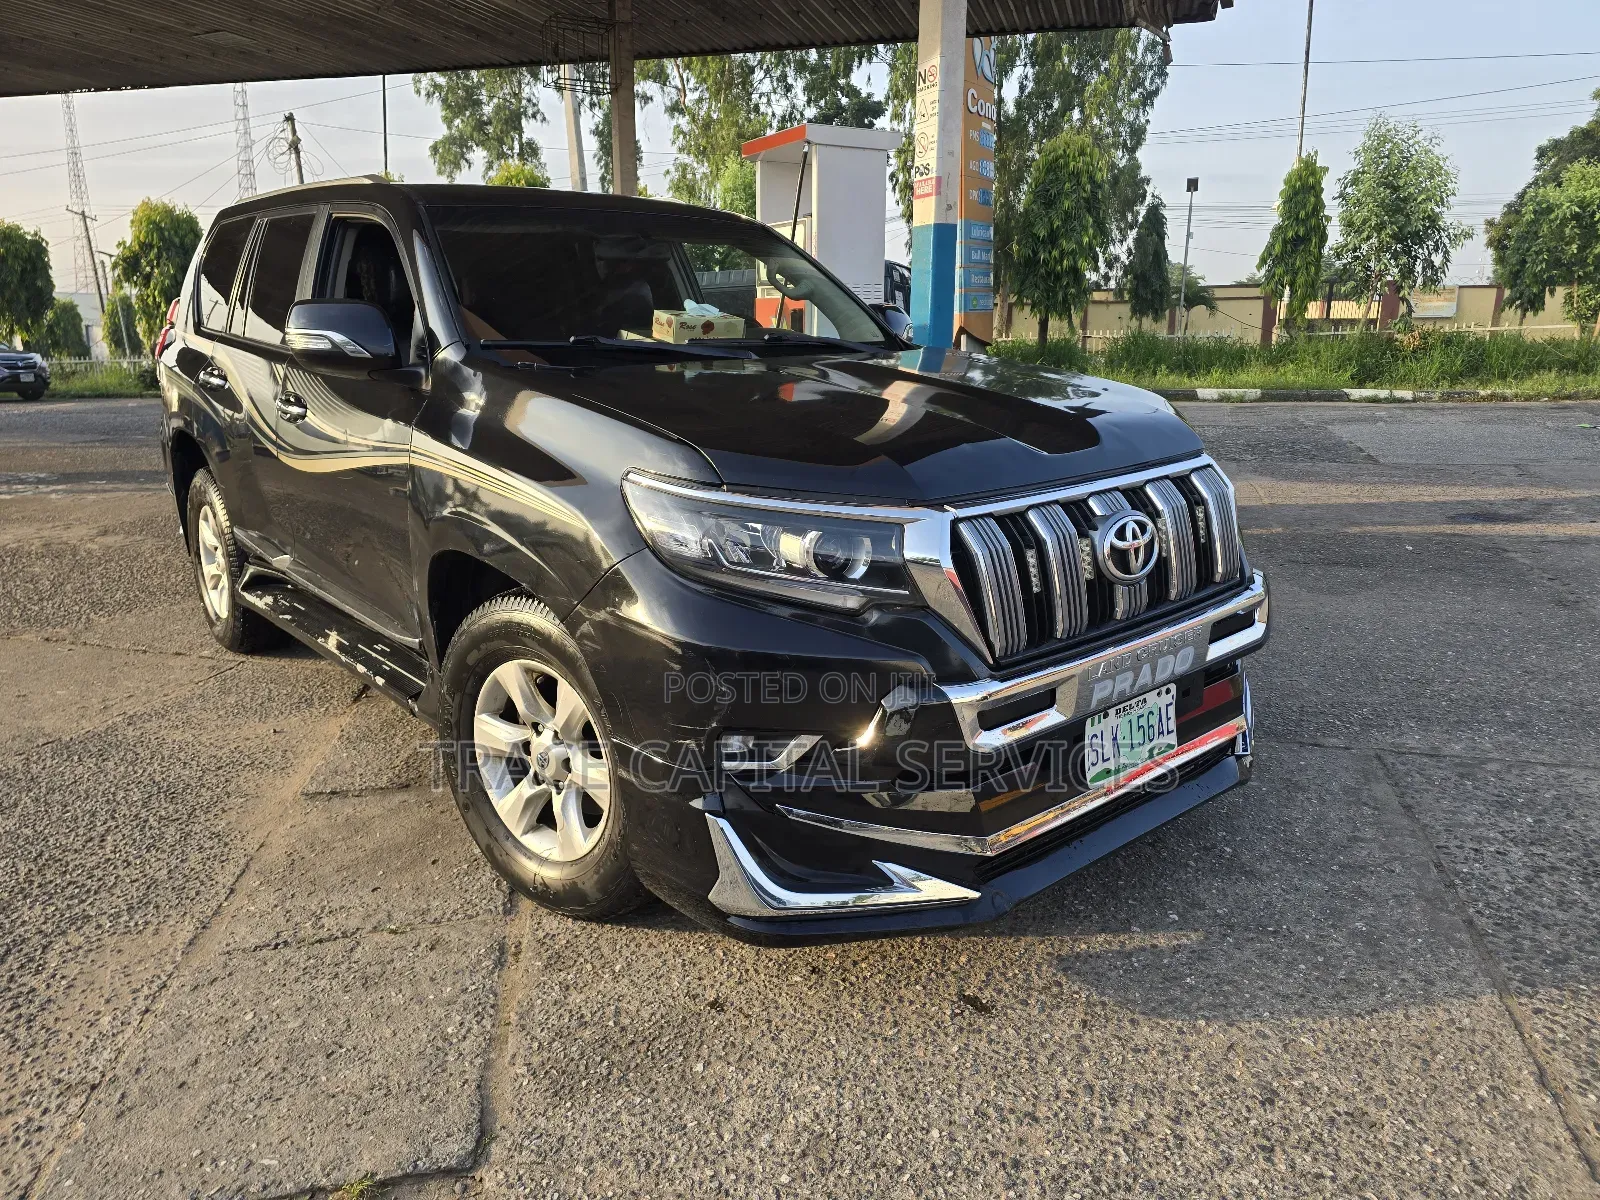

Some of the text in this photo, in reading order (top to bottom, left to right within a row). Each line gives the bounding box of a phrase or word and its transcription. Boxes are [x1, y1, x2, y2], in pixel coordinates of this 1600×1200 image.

[969, 129, 980, 142] PMS
[915, 184, 933, 196] HERE
[679, 321, 697, 330] Rose
[1087, 625, 1203, 682] LAND CRUISER
[1090, 645, 1195, 709] PRADO
[1115, 697, 1148, 716] DELTA
